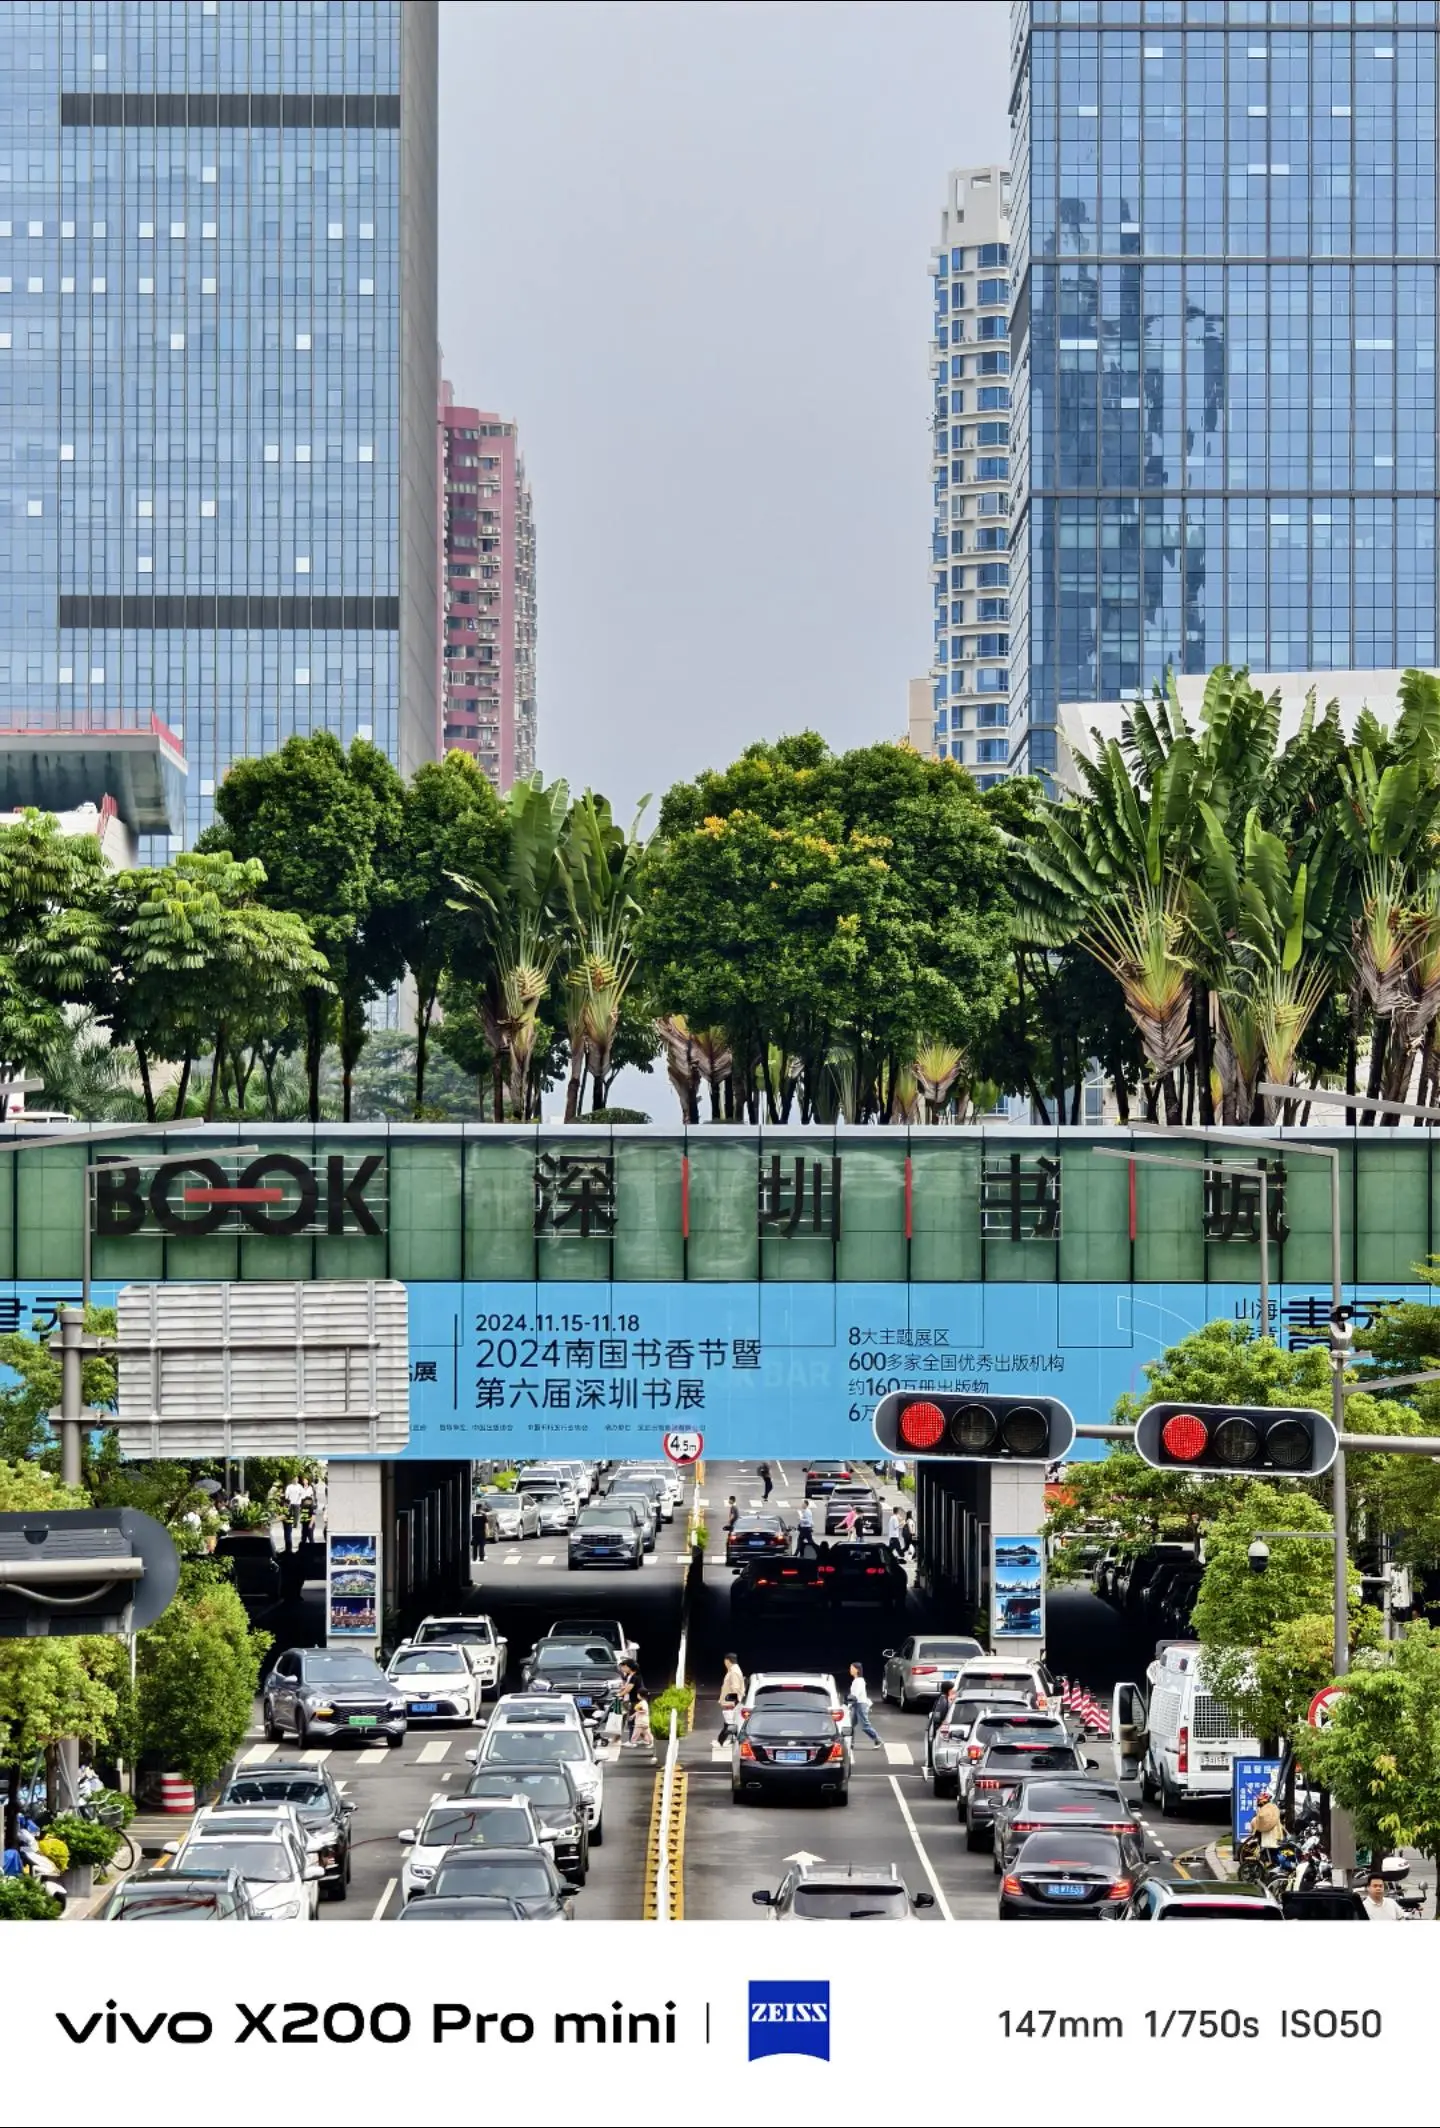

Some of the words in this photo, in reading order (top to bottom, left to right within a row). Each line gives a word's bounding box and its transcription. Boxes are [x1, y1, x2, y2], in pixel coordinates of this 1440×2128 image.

[96, 1154, 384, 1236] BOOK
[475, 1314, 640, 1332] 2024.11.15-11.18
[848, 1327, 950, 1346] 8大主题展区
[475, 1338, 762, 1370] 2024南国书香节暨
[849, 1352, 1065, 1372] 600多家全国优秀出版机构
[409, 1361, 438, 1382] 展
[475, 1376, 706, 1410] 第六届深圳书展
[670, 1435, 697, 1451] 4.5m
